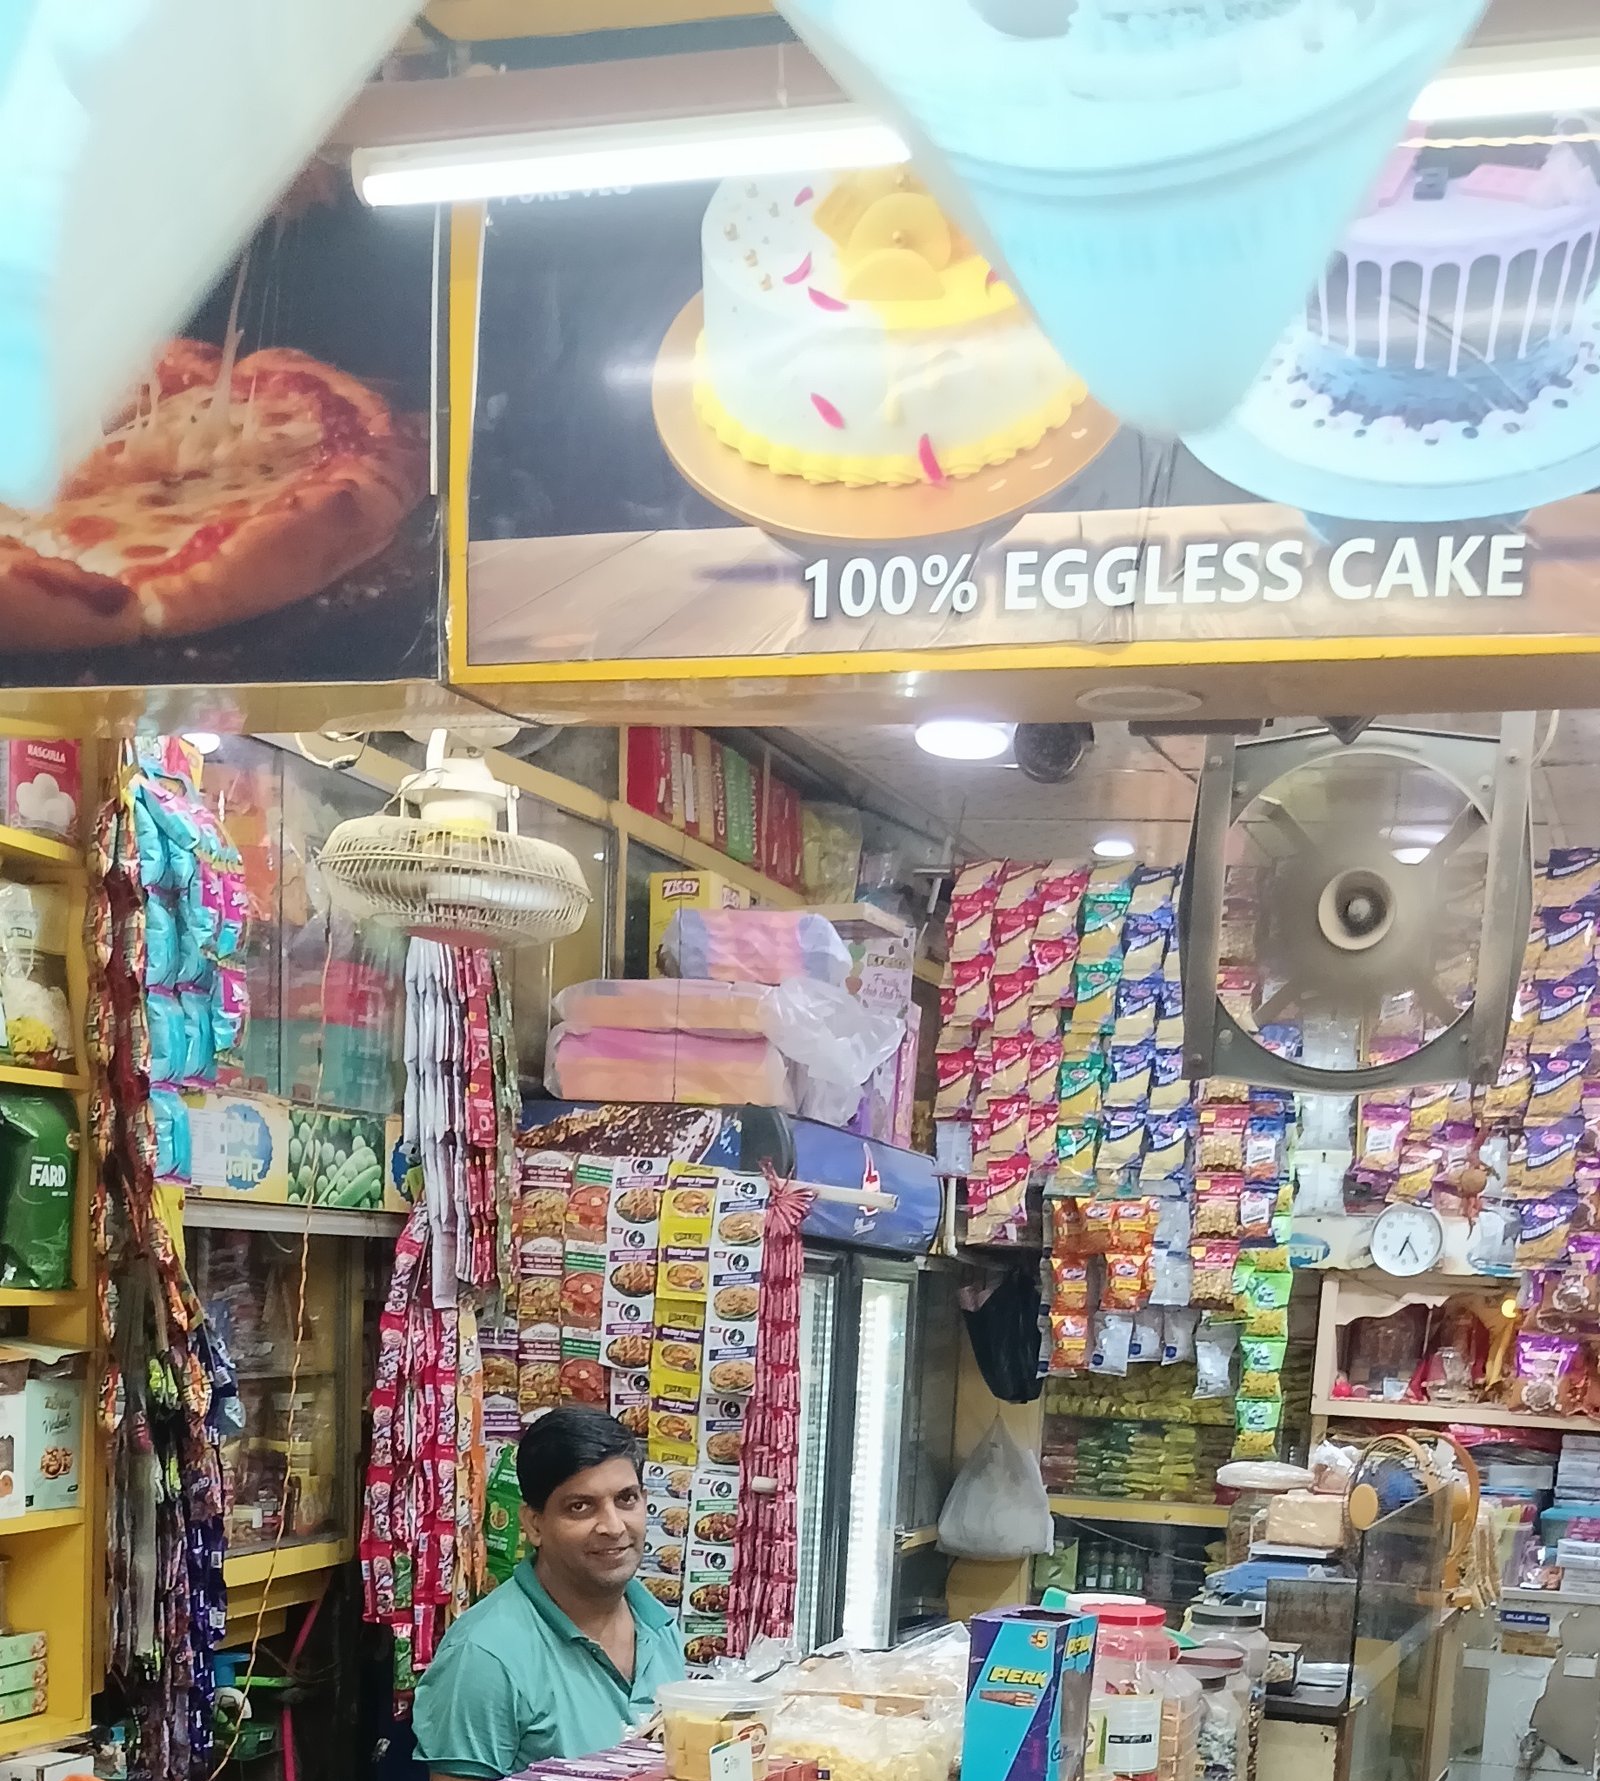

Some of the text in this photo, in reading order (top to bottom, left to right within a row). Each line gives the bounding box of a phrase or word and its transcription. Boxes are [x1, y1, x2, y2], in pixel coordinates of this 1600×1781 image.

[804, 534, 1527, 618] 100% EGGLESS CAKE
[988, 1666, 1047, 1689] PERK
